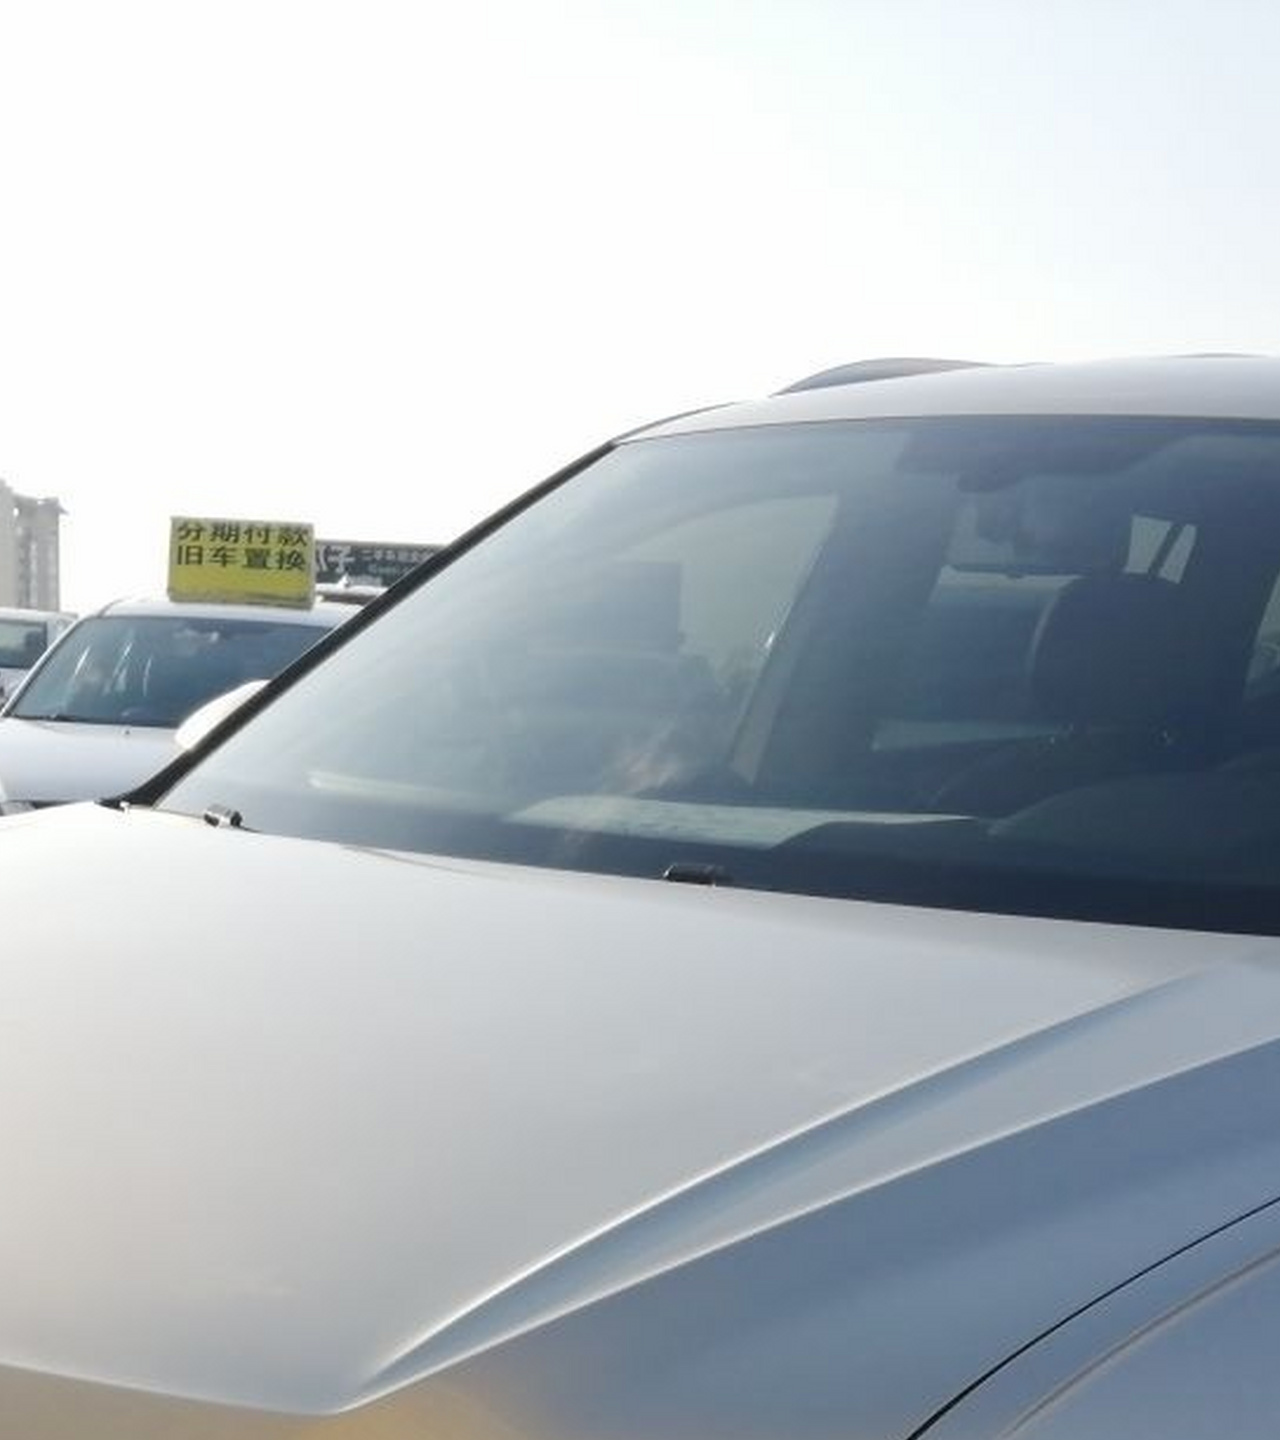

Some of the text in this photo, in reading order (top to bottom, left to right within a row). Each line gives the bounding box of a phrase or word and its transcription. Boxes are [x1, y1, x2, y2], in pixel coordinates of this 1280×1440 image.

[177, 522, 309, 547] 分期付款
[177, 544, 307, 571] 旧车置换
